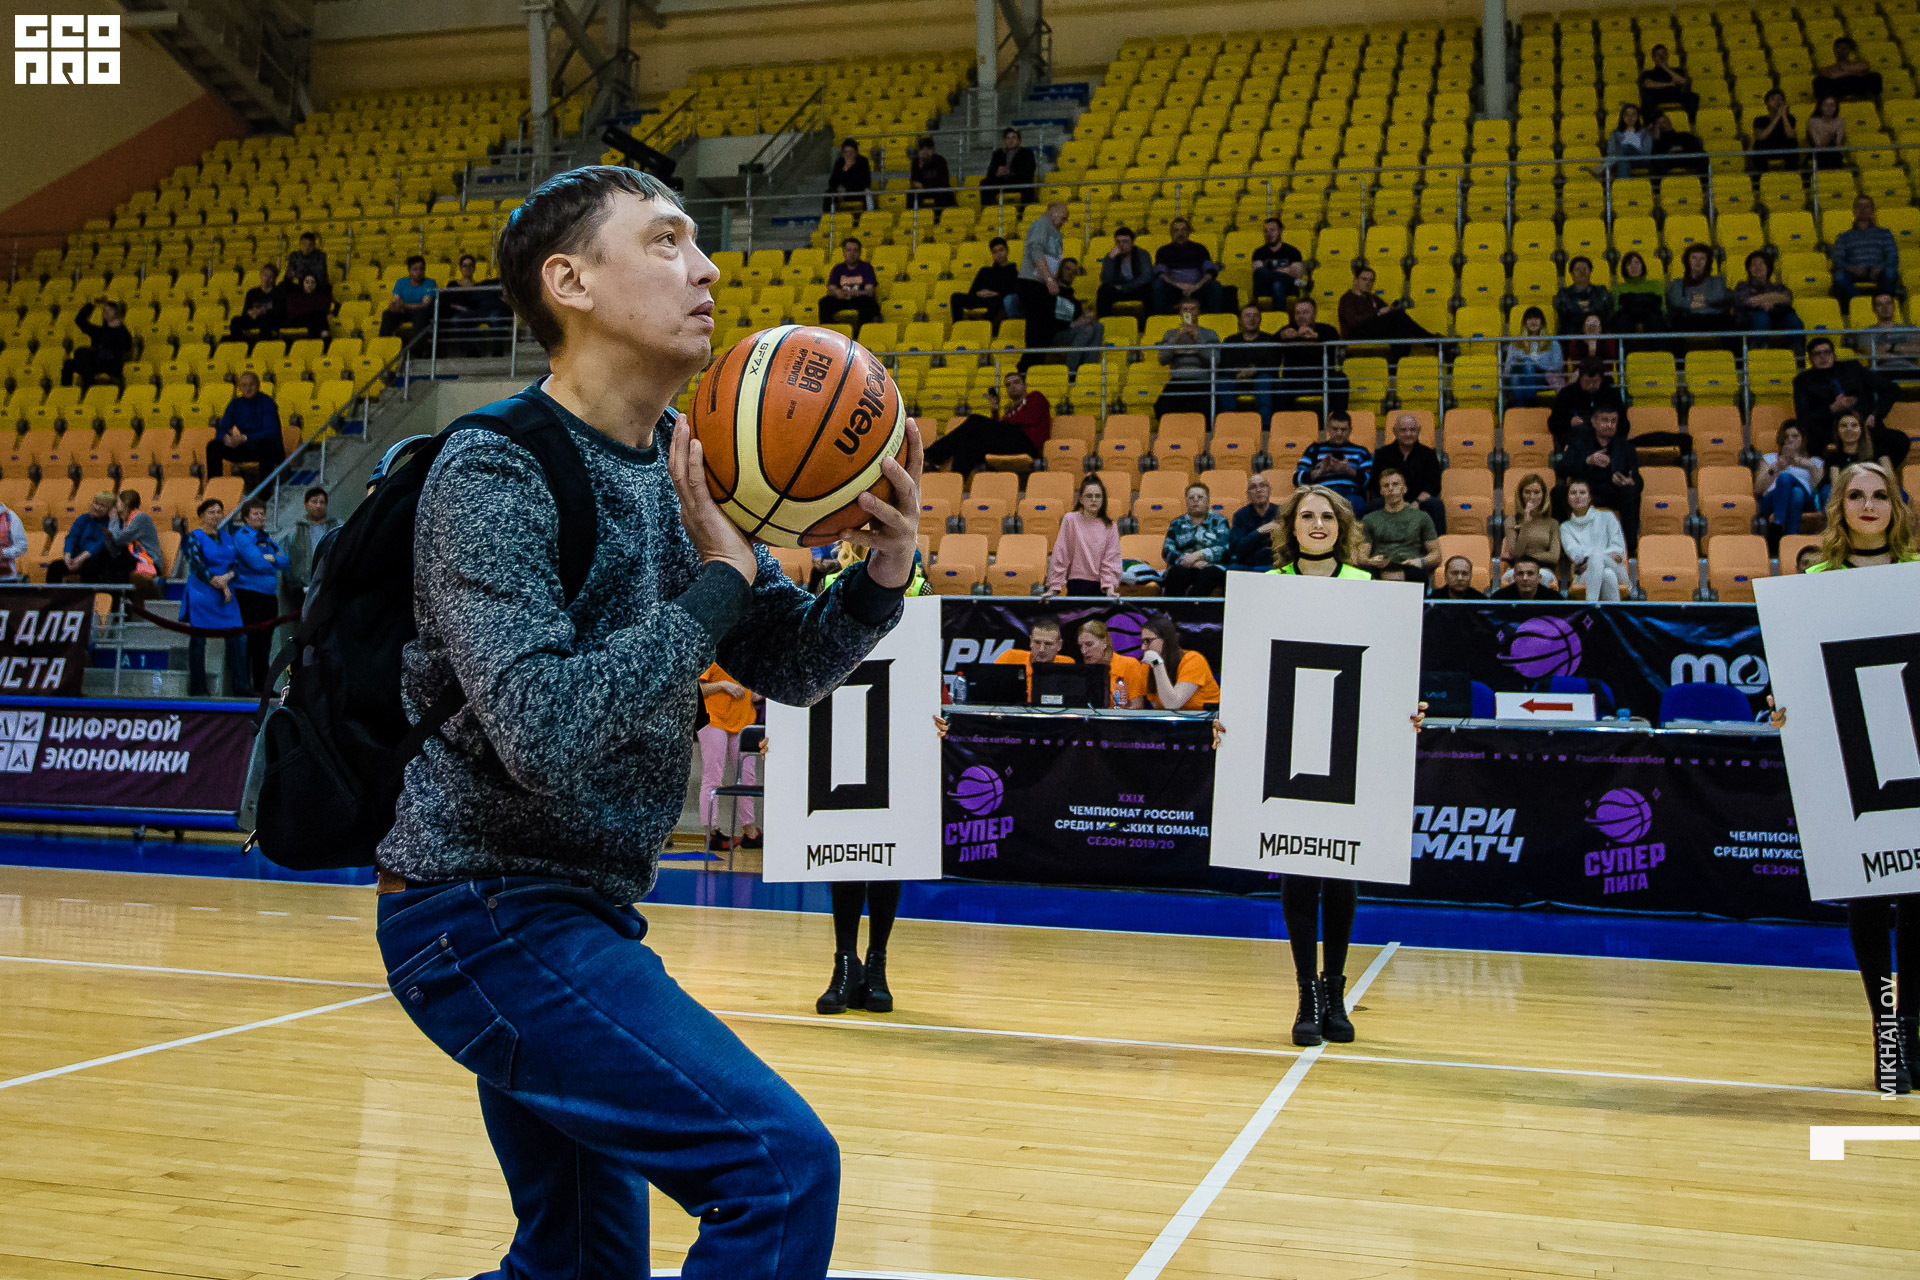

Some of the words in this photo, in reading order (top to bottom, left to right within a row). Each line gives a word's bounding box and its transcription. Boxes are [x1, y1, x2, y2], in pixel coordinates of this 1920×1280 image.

[749, 342, 769, 376] GF7X
[798, 351, 833, 393] FIBA
[833, 353, 886, 456] molten
[14, 610, 85, 646] ДЛЯ
[49, 714, 182, 743] ЦИФРОВОЙ
[41, 747, 190, 774] ЭКОНОМИКИ
[1069, 805, 1141, 818] ЧЕМПИОНАТ
[1143, 809, 1194, 821] РОССИИ
[1412, 805, 1516, 835] ПАРИ
[944, 816, 1013, 845] СУПЕР
[1055, 819, 1093, 832] СРЕДИ
[1156, 825, 1209, 837] КОМАНД
[1087, 836, 1126, 847] СЕЗОН
[1129, 838, 1175, 849] 2019/20
[806, 842, 896, 870] MADSHOT
[959, 843, 998, 862] ЛИГА
[1259, 831, 1361, 865] MADSHOT
[1410, 833, 1525, 863] МАТЧ
[1584, 843, 1665, 876] СУПЕР
[1713, 846, 1759, 859] СРЕДИ
[1603, 873, 1649, 894] ЛИГА
[1752, 864, 1799, 875] СЕЗОН
